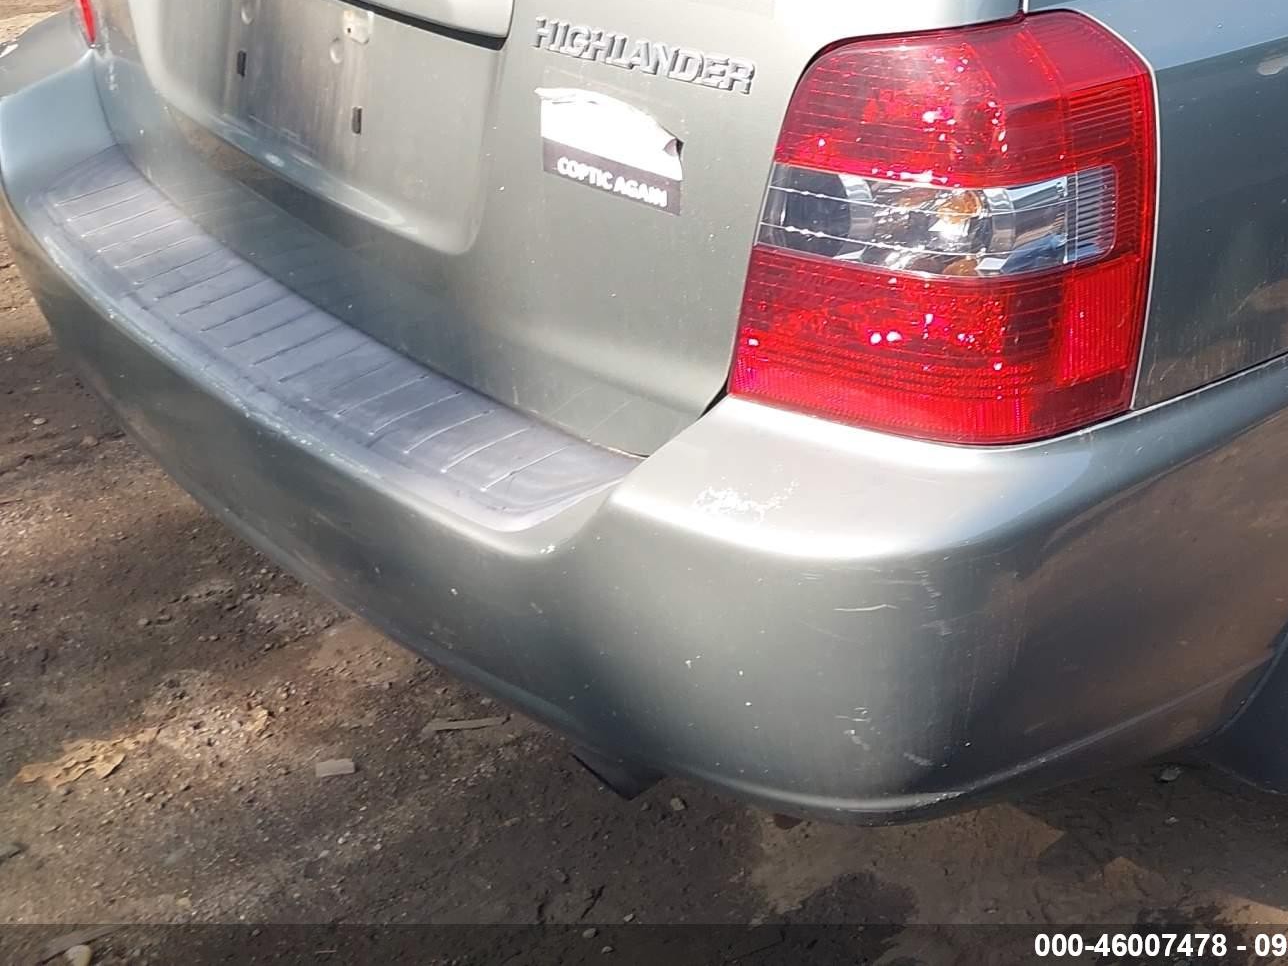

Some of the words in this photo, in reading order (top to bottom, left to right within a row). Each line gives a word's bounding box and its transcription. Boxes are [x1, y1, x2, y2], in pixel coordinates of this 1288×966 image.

[532, 16, 756, 95] HIGHLANDER
[557, 156, 613, 190] COPTIC
[613, 176, 668, 207] AGAIN
